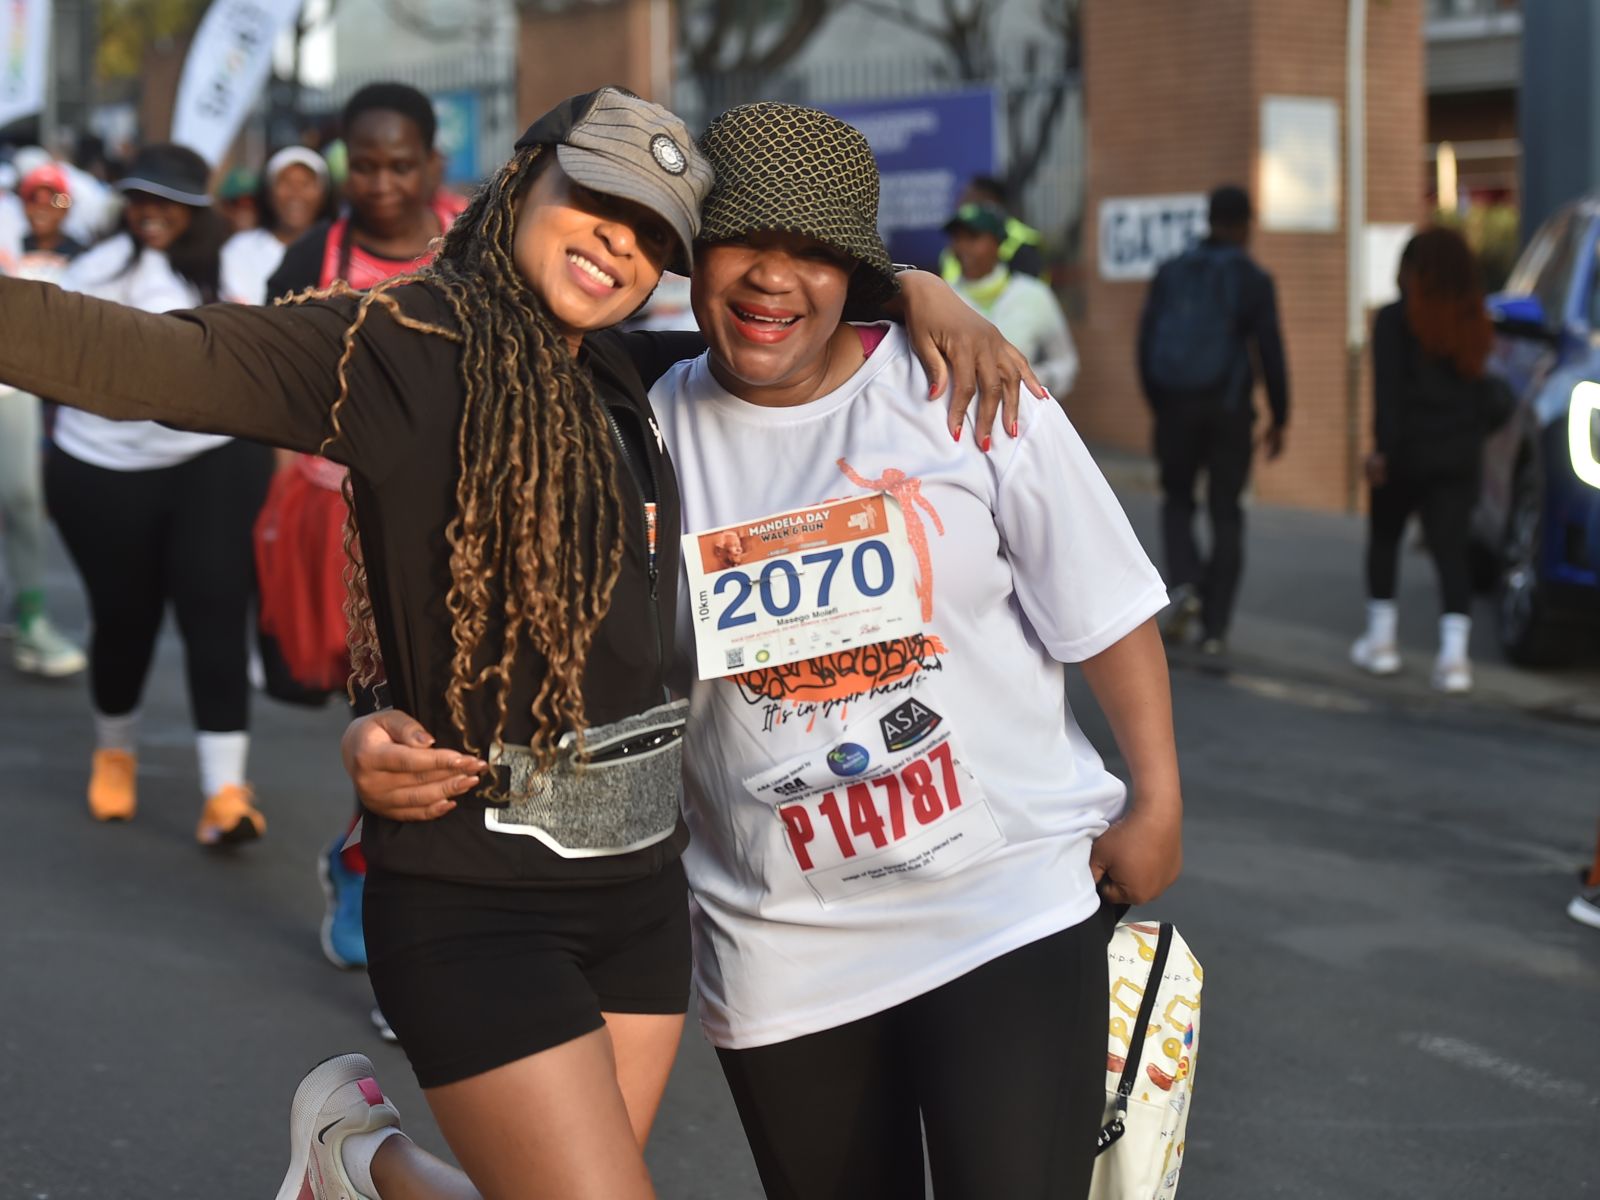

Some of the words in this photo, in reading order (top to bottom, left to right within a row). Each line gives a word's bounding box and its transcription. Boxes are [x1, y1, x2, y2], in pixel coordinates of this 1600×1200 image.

[748, 516, 804, 537] MANDELA
[806, 510, 831, 523] DAY
[760, 530, 790, 543] WALK
[802, 523, 824, 533] RUN
[713, 540, 895, 631] 2070
[700, 590, 709, 622] 10km
[797, 700, 819, 717] in
[822, 691, 865, 719] your
[883, 703, 929, 740] ASA
